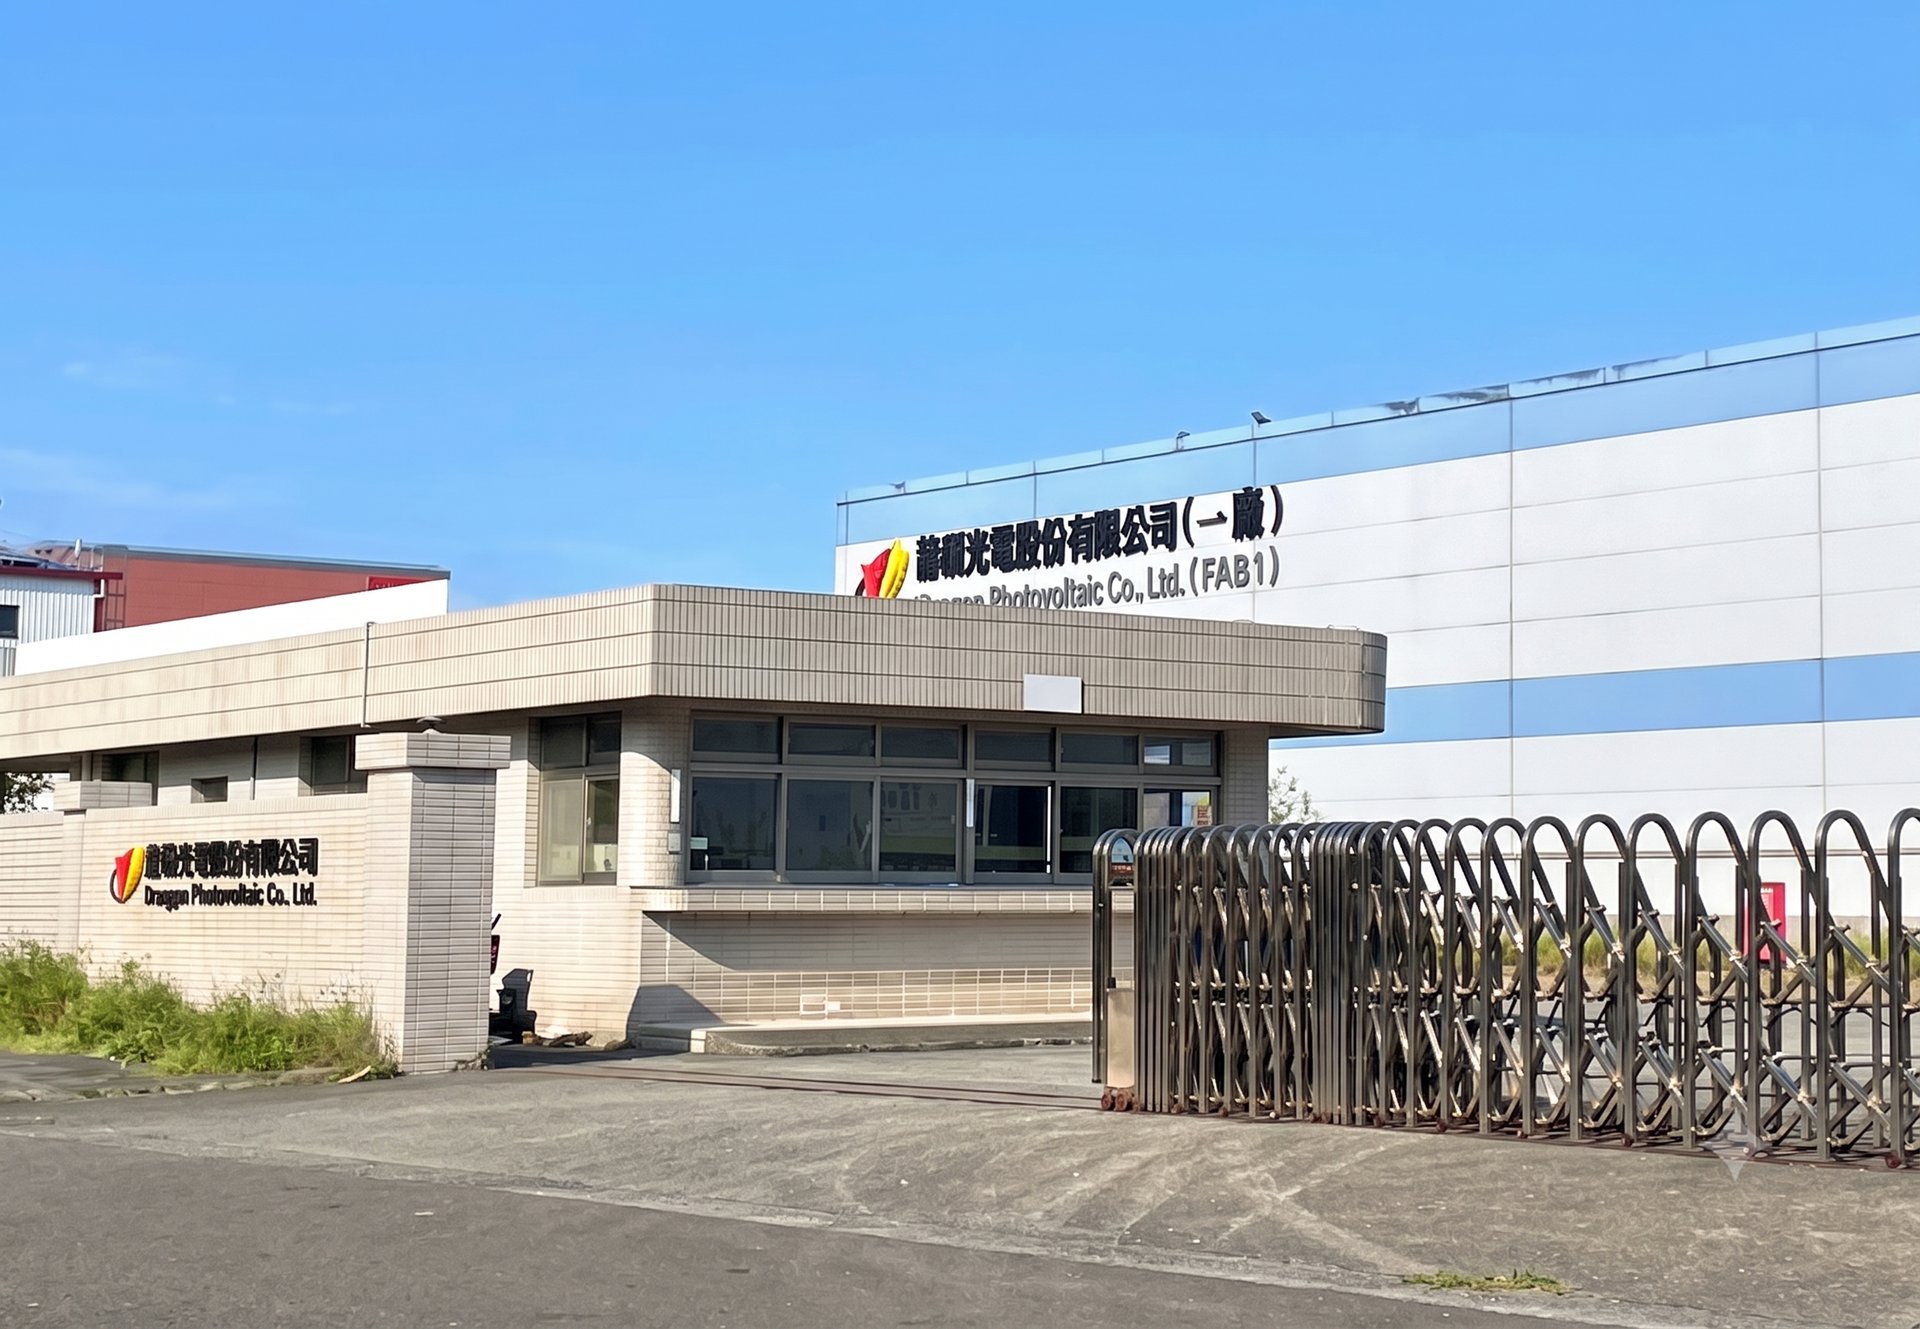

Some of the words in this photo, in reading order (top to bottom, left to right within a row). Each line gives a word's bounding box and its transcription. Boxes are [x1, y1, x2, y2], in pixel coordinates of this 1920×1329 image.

[989, 575, 1104, 609] Photovoltaic
[1147, 563, 1185, 599] Ltd.
[1189, 545, 1280, 597] (FAB1)
[191, 882, 264, 907] Photovoltaic
[293, 882, 317, 906] Ltd.
